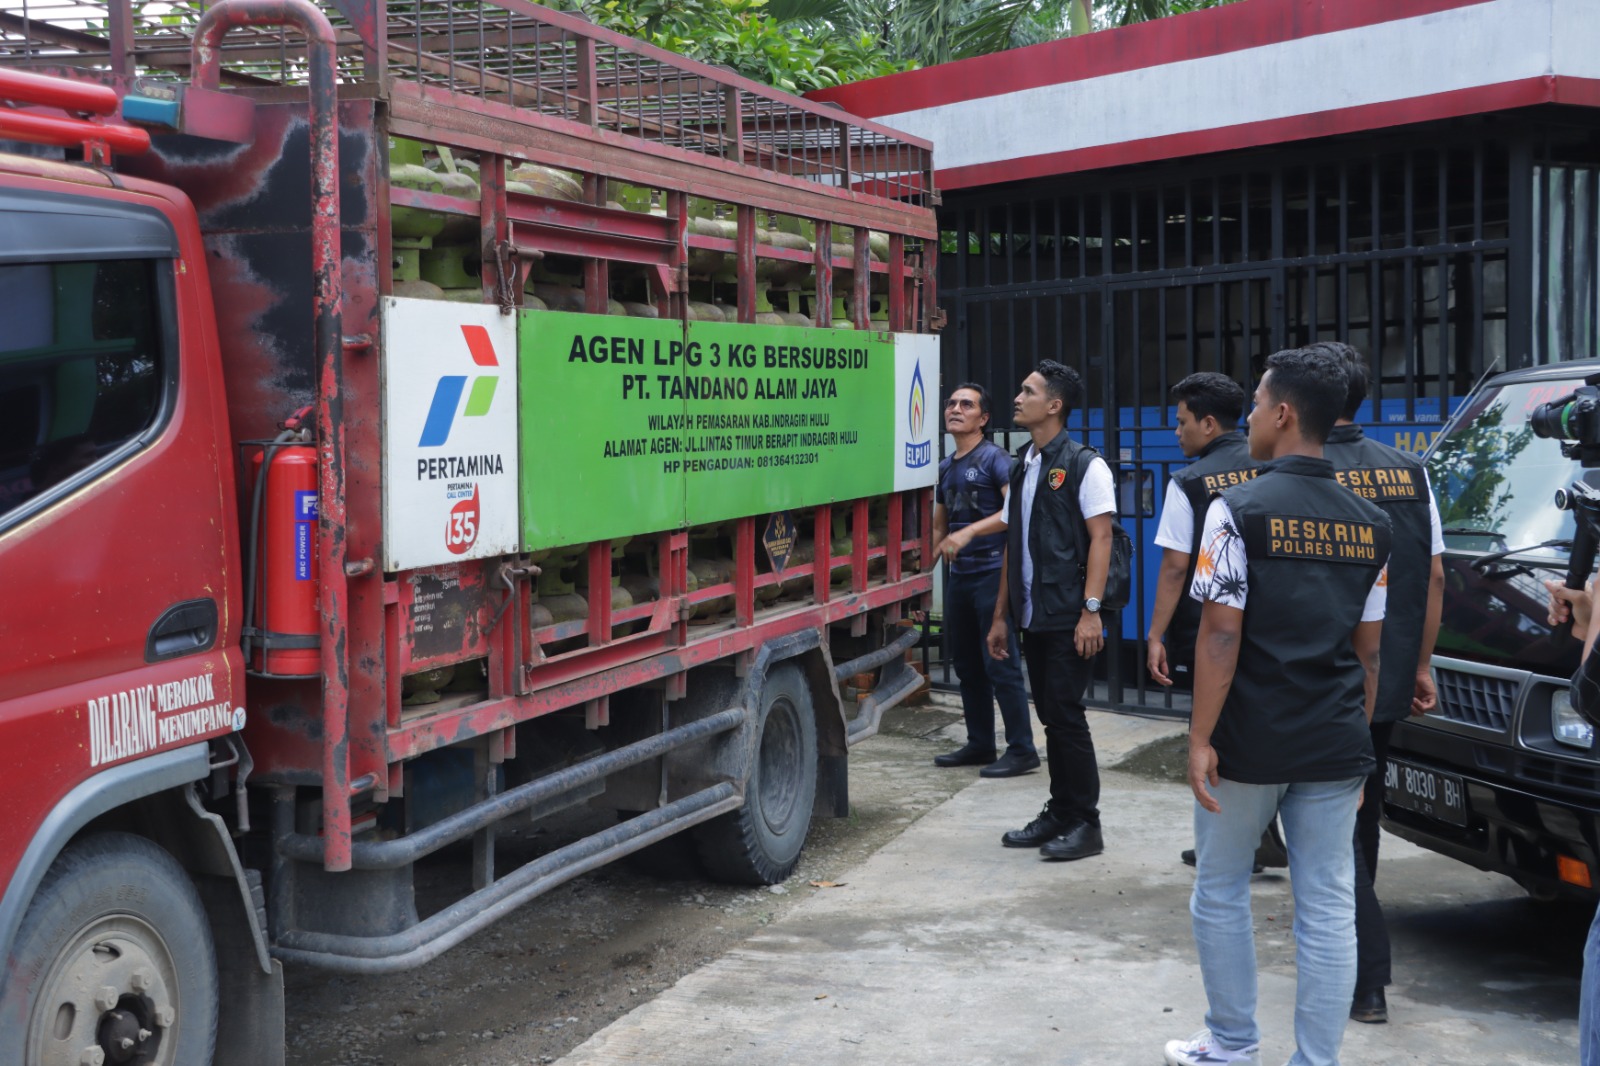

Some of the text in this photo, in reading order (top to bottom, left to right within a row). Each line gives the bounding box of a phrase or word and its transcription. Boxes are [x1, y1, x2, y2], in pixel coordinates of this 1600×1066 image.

[568, 335, 868, 369] AGEN LPG 3 KG BERSUBSIDI
[622, 374, 838, 400] PT. TANDANO ALAM JAYA
[648, 414, 694, 431] WILAYAH
[696, 414, 750, 429] PEMASARAN
[810, 413, 830, 427] HULU
[603, 438, 647, 458] ALAMAT
[650, 437, 683, 455] AGEN:
[735, 434, 763, 450] TIMUR
[765, 433, 798, 449] BERAPIT
[800, 431, 838, 447] INDRAGIRI
[840, 430, 858, 445] HULU
[907, 444, 930, 467] ELPIJI
[417, 453, 504, 481] PERTAMINA
[663, 453, 819, 473] HP PENGADUAN: 081364132301
[447, 482, 473, 491] PERTAMINA
[1335, 469, 1412, 487] ESKRIM
[446, 490, 472, 499] CALL CENTER
[1382, 486, 1415, 497] INHU
[447, 511, 475, 546] 135
[1270, 518, 1374, 545] RESKRIM
[1272, 540, 1375, 559] POLRES INHU
[88, 673, 215, 768] DILARANG MEROKOK
[158, 701, 232, 745] MENUMPANG
[1405, 767, 1437, 800] 8030
[1444, 779, 1461, 808] BH
